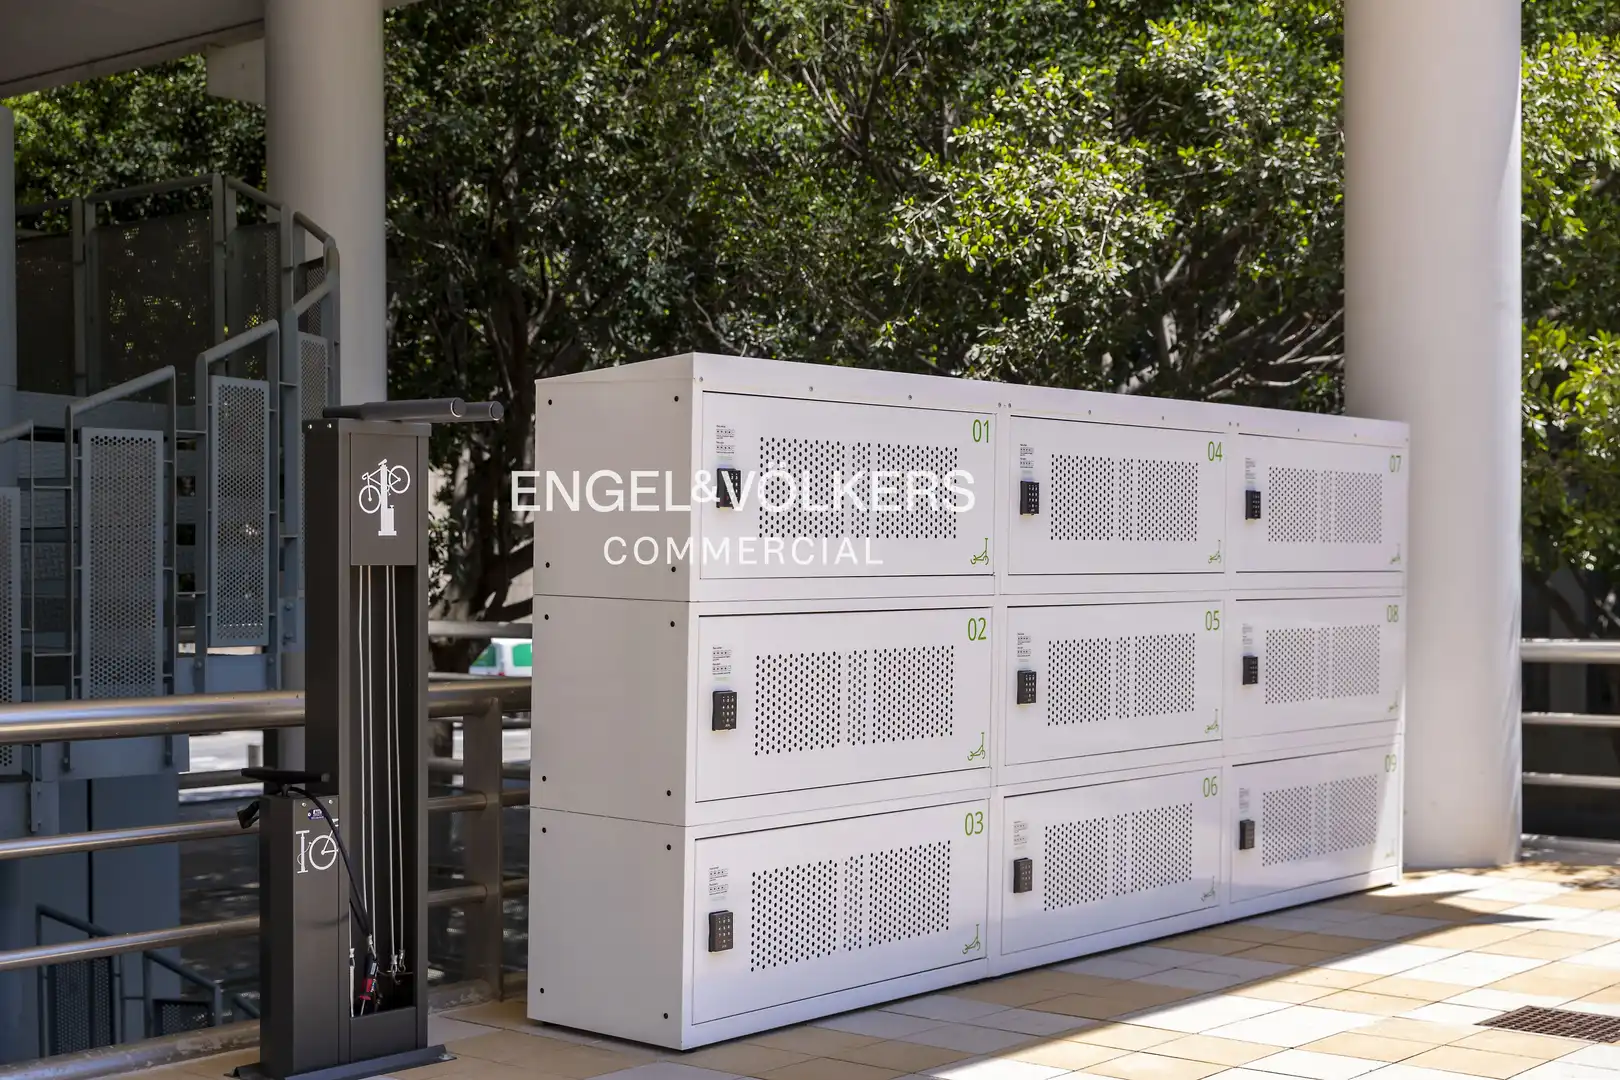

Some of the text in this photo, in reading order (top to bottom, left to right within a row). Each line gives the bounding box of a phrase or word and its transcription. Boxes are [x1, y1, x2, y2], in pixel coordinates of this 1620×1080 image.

[971, 418, 989, 443] 01
[1207, 441, 1223, 462] 04
[1389, 454, 1402, 474] 07
[1205, 610, 1221, 631] 05
[1386, 604, 1399, 623] 08
[967, 617, 987, 641] 02
[1203, 776, 1218, 798] 06
[964, 811, 983, 836] 03
